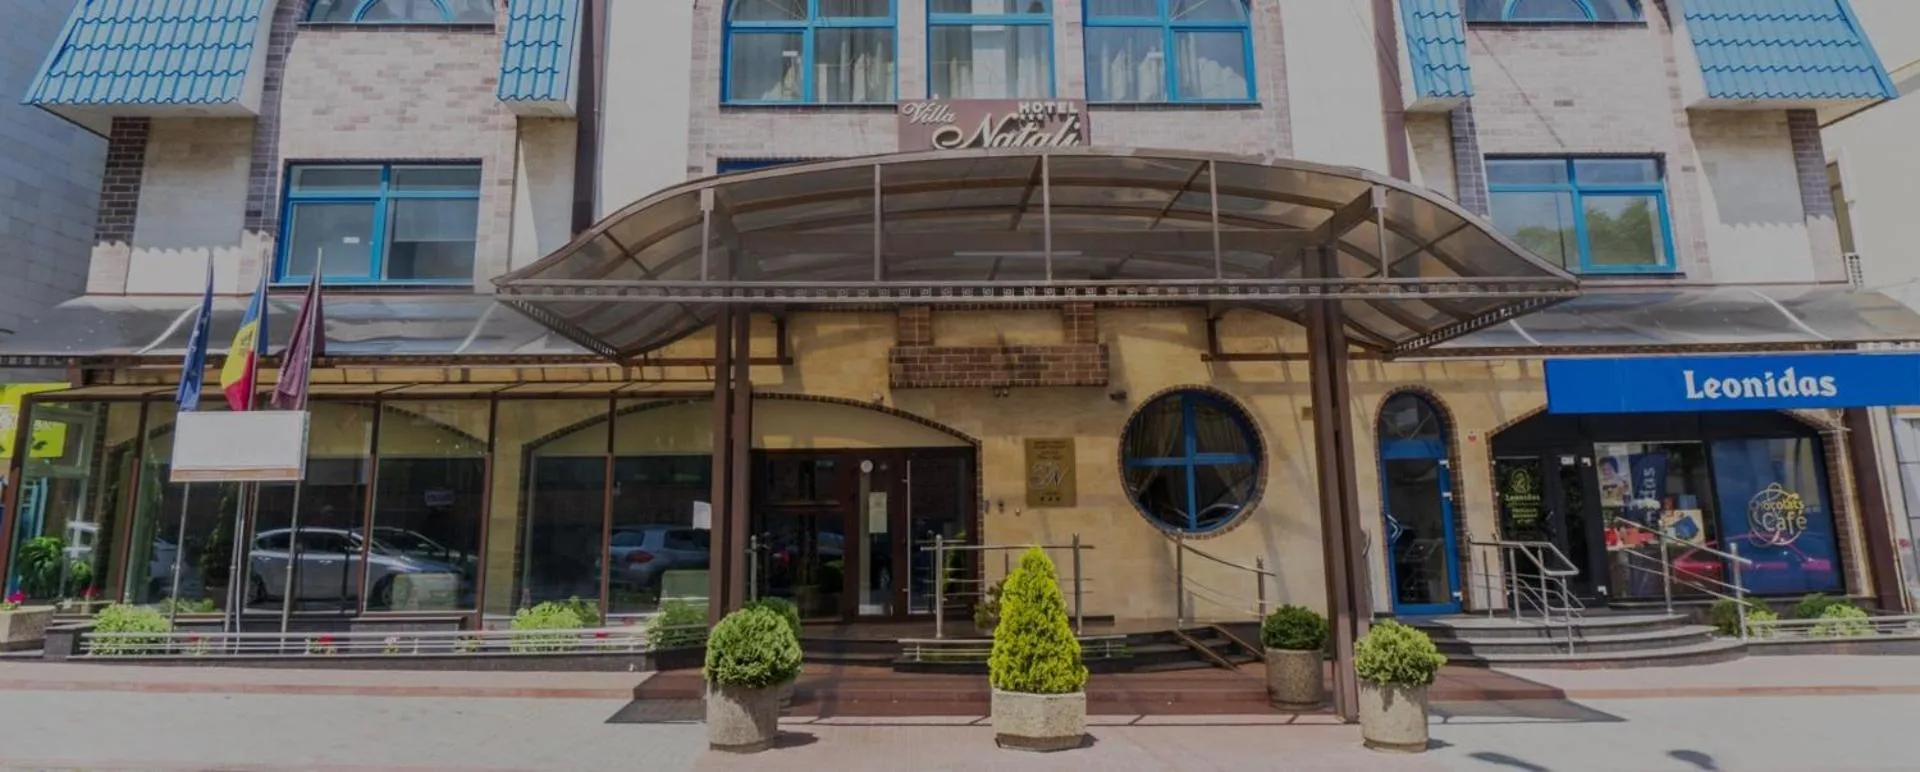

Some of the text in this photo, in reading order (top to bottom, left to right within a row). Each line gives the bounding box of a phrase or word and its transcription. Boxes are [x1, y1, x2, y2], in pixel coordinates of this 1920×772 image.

[902, 95, 957, 124] Villa
[1019, 101, 1079, 113] HOTEL
[932, 113, 1081, 149] Natali
[1683, 366, 1837, 399] Leonidas
[1762, 509, 1807, 535] Café
